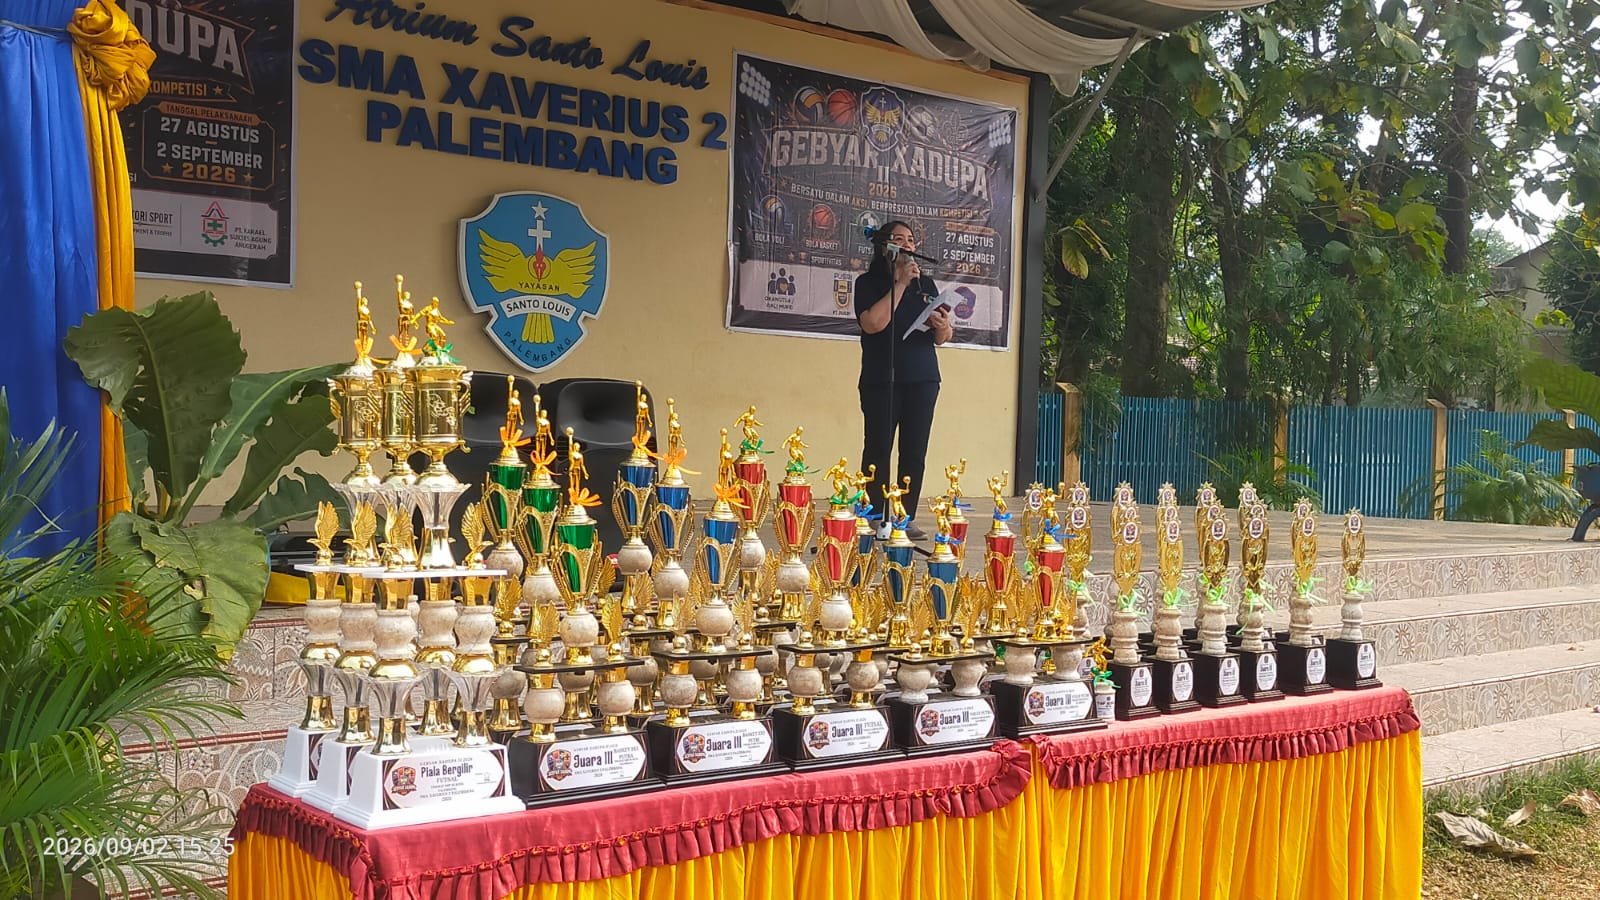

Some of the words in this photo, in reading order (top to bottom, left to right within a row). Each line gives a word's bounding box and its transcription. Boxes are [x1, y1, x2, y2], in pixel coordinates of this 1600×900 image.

[492, 16, 604, 69] Santo
[611, 39, 711, 90] Louis
[297, 38, 426, 100] SMA
[440, 62, 691, 143] XAVERIUS
[700, 111, 728, 151] 2
[160, 117, 181, 133] 27
[186, 121, 260, 144] AGUSTUS
[366, 100, 679, 185] PALEMBANG
[157, 142, 167, 157] 2
[171, 143, 263, 170] SEPTEMBER
[182, 163, 236, 184] 2026
[771, 131, 880, 169] GEBYAR
[891, 147, 989, 200] XADUPA
[868, 182, 897, 199] 2026
[791, 183, 825, 200] BERSATU
[825, 191, 850, 205] DALAM
[871, 200, 915, 214] BERPRESTASI
[916, 206, 939, 217] DALAM
[133, 210, 148, 223] ORI
[150, 211, 173, 225] SPORT
[945, 231, 957, 243] 27
[958, 233, 995, 248] AGUSTUS
[943, 248, 949, 260] 2
[950, 249, 996, 265] SEPTEMBER
[955, 262, 981, 274] 2026
[518, 281, 561, 292] YAYASAN
[506, 300, 540, 313] SANTO
[542, 300, 571, 317] LOUIS
[503, 330, 573, 362] PALEMBANG
[1045, 695, 1064, 707] Juara
[940, 713, 961, 726] Juara
[962, 710, 970, 723] III
[831, 725, 854, 738] Juara
[855, 723, 863, 735] III
[706, 738, 732, 752] Juara
[733, 735, 742, 749] III
[573, 754, 602, 769] Juara
[604, 750, 613, 765] III
[421, 766, 441, 779] Piala
[442, 762, 474, 778] Bergilir
